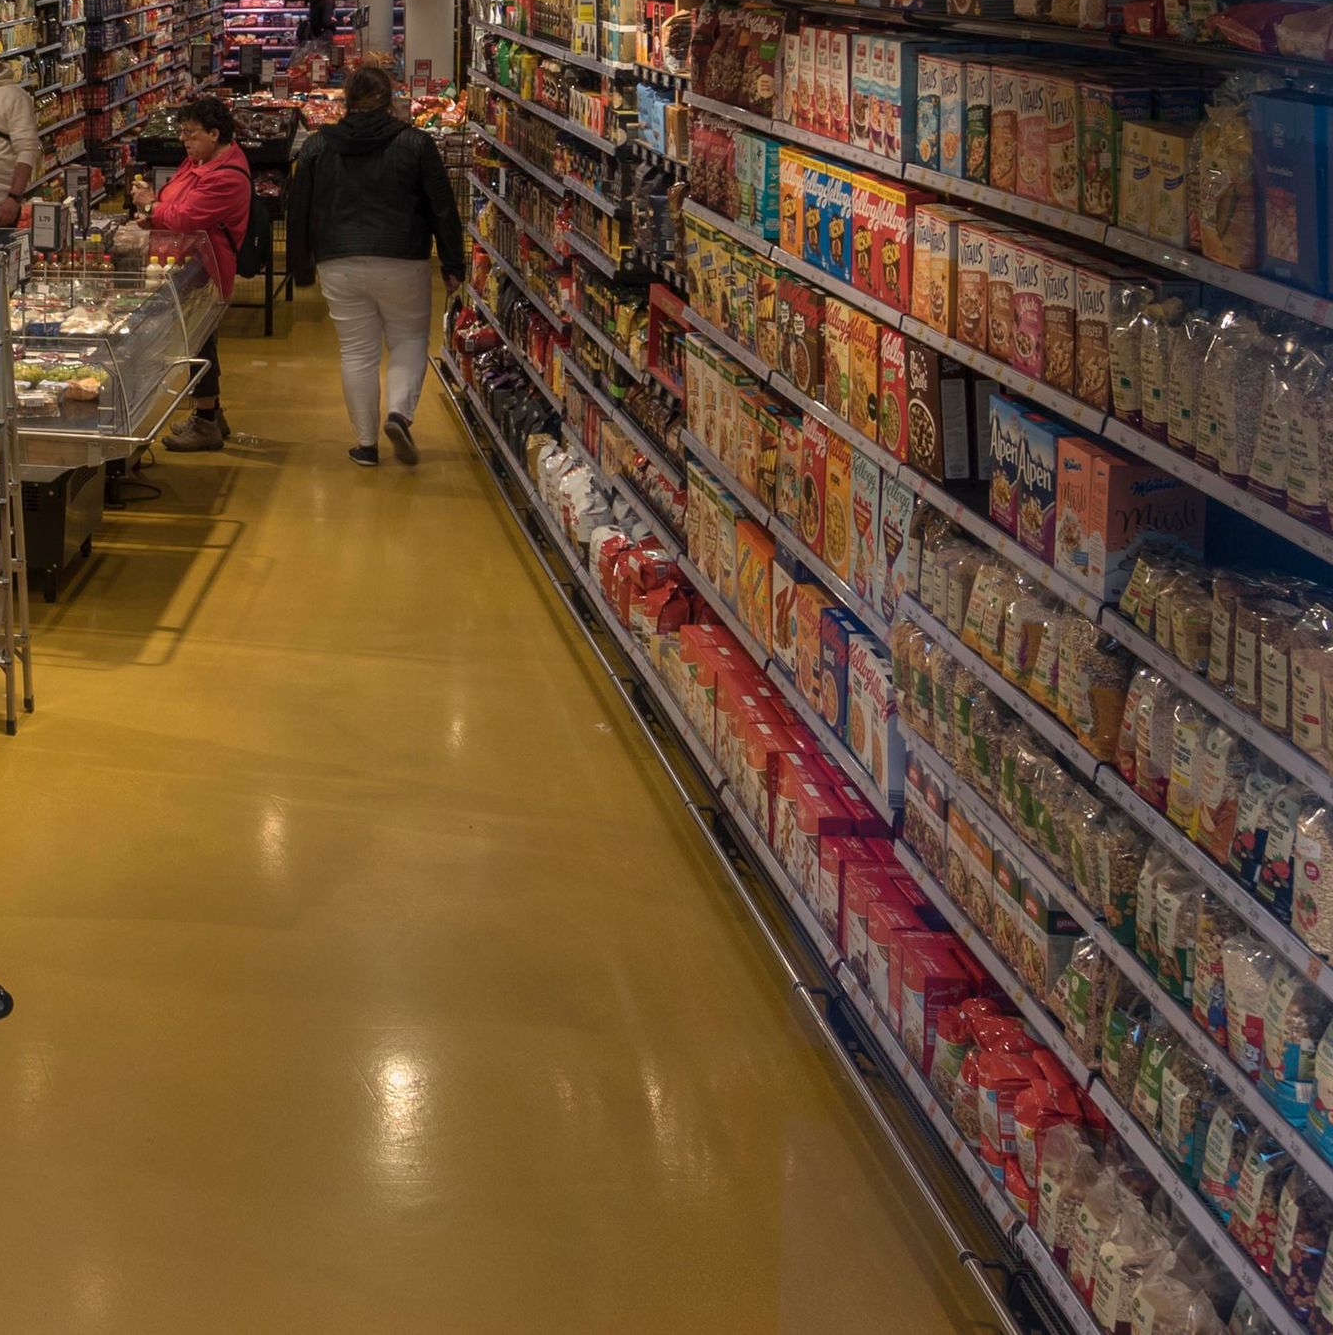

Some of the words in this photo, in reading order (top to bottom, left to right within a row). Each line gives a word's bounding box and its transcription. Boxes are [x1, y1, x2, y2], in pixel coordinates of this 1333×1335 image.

[1019, 87, 1044, 115] VITALIS
[1045, 96, 1074, 124] VITALIS
[960, 242, 983, 266] VITALIS
[989, 252, 1010, 277] VITALIS
[1015, 264, 1039, 289] VITALIS
[1044, 274, 1069, 301] VITALIS
[1078, 288, 1105, 315] VITALIS
[988, 423, 1018, 464] Alpen
[1017, 437, 1052, 492] Alpen
[1060, 480, 1087, 514] Müsli
[1131, 478, 1183, 501] Manner
[1116, 496, 1197, 534] Müsli
